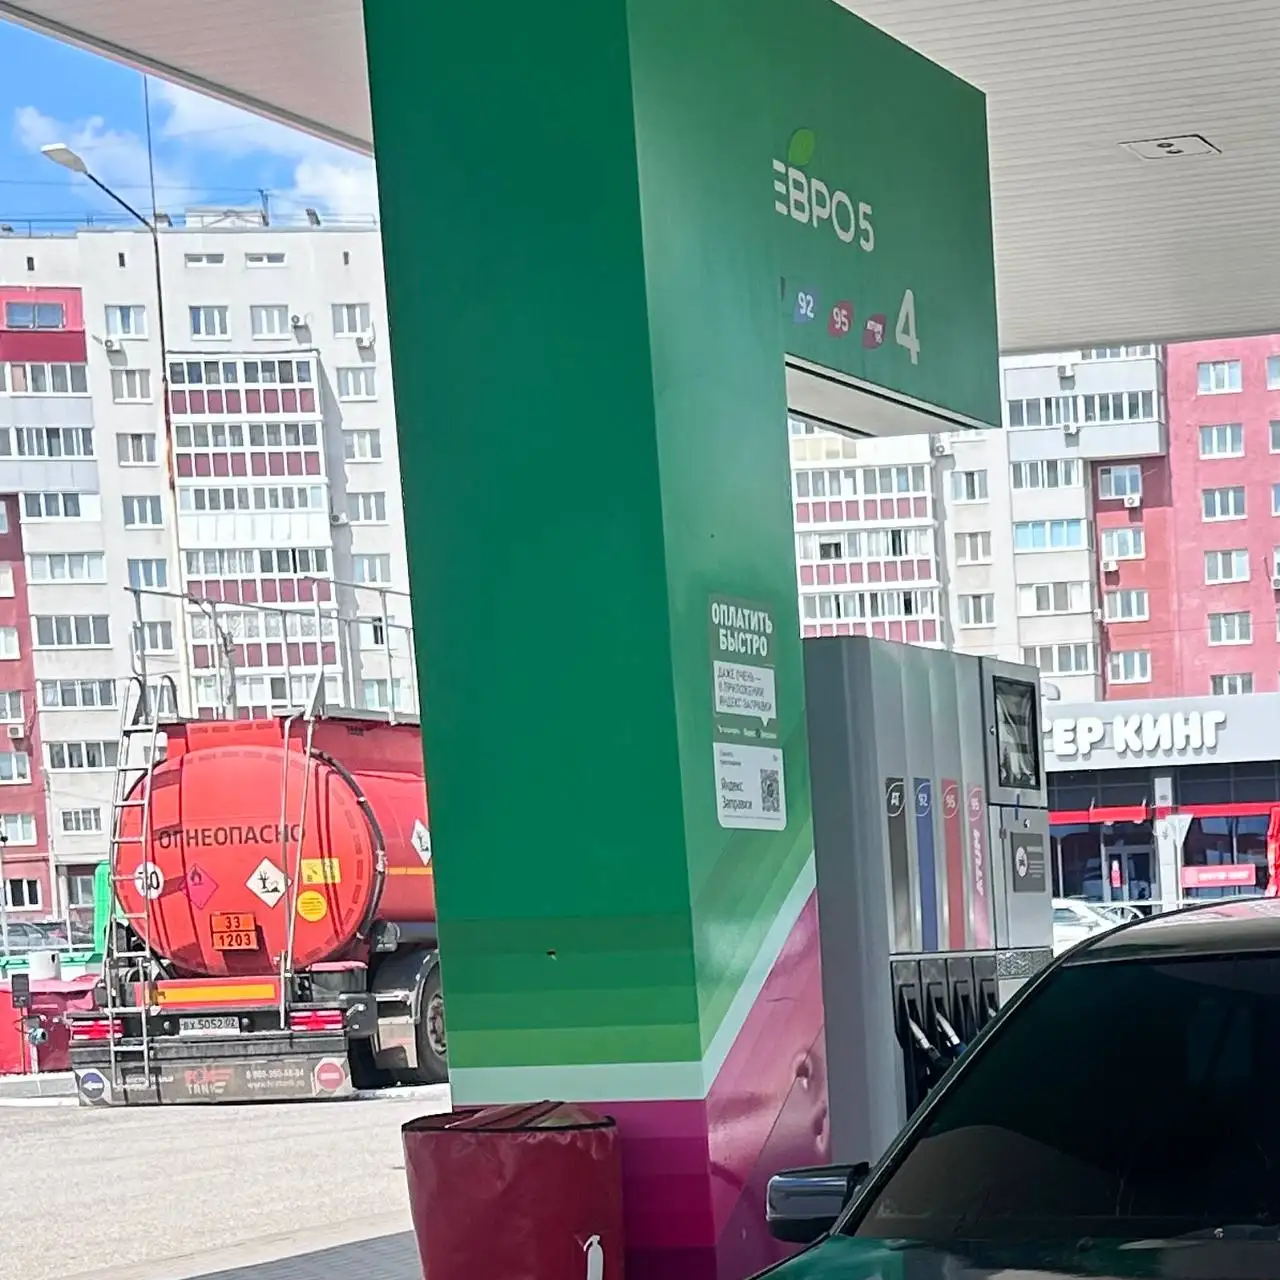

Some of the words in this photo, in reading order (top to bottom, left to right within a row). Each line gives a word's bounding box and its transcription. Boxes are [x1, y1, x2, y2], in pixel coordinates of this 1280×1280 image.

[798, 291, 815, 319] 92
[832, 307, 849, 332] 95
[895, 288, 920, 365] 4
[711, 602, 773, 634] ОПЛАТИТЬ
[719, 628, 768, 657] БЫСТРО
[1042, 716, 1104, 756] ЕР
[1112, 710, 1227, 753] КИНГ
[158, 823, 306, 850] ОГНЕОПАСНО
[225, 915, 241, 930] 33
[218, 932, 252, 948] 1203
[198, 1018, 223, 1030] 5052
